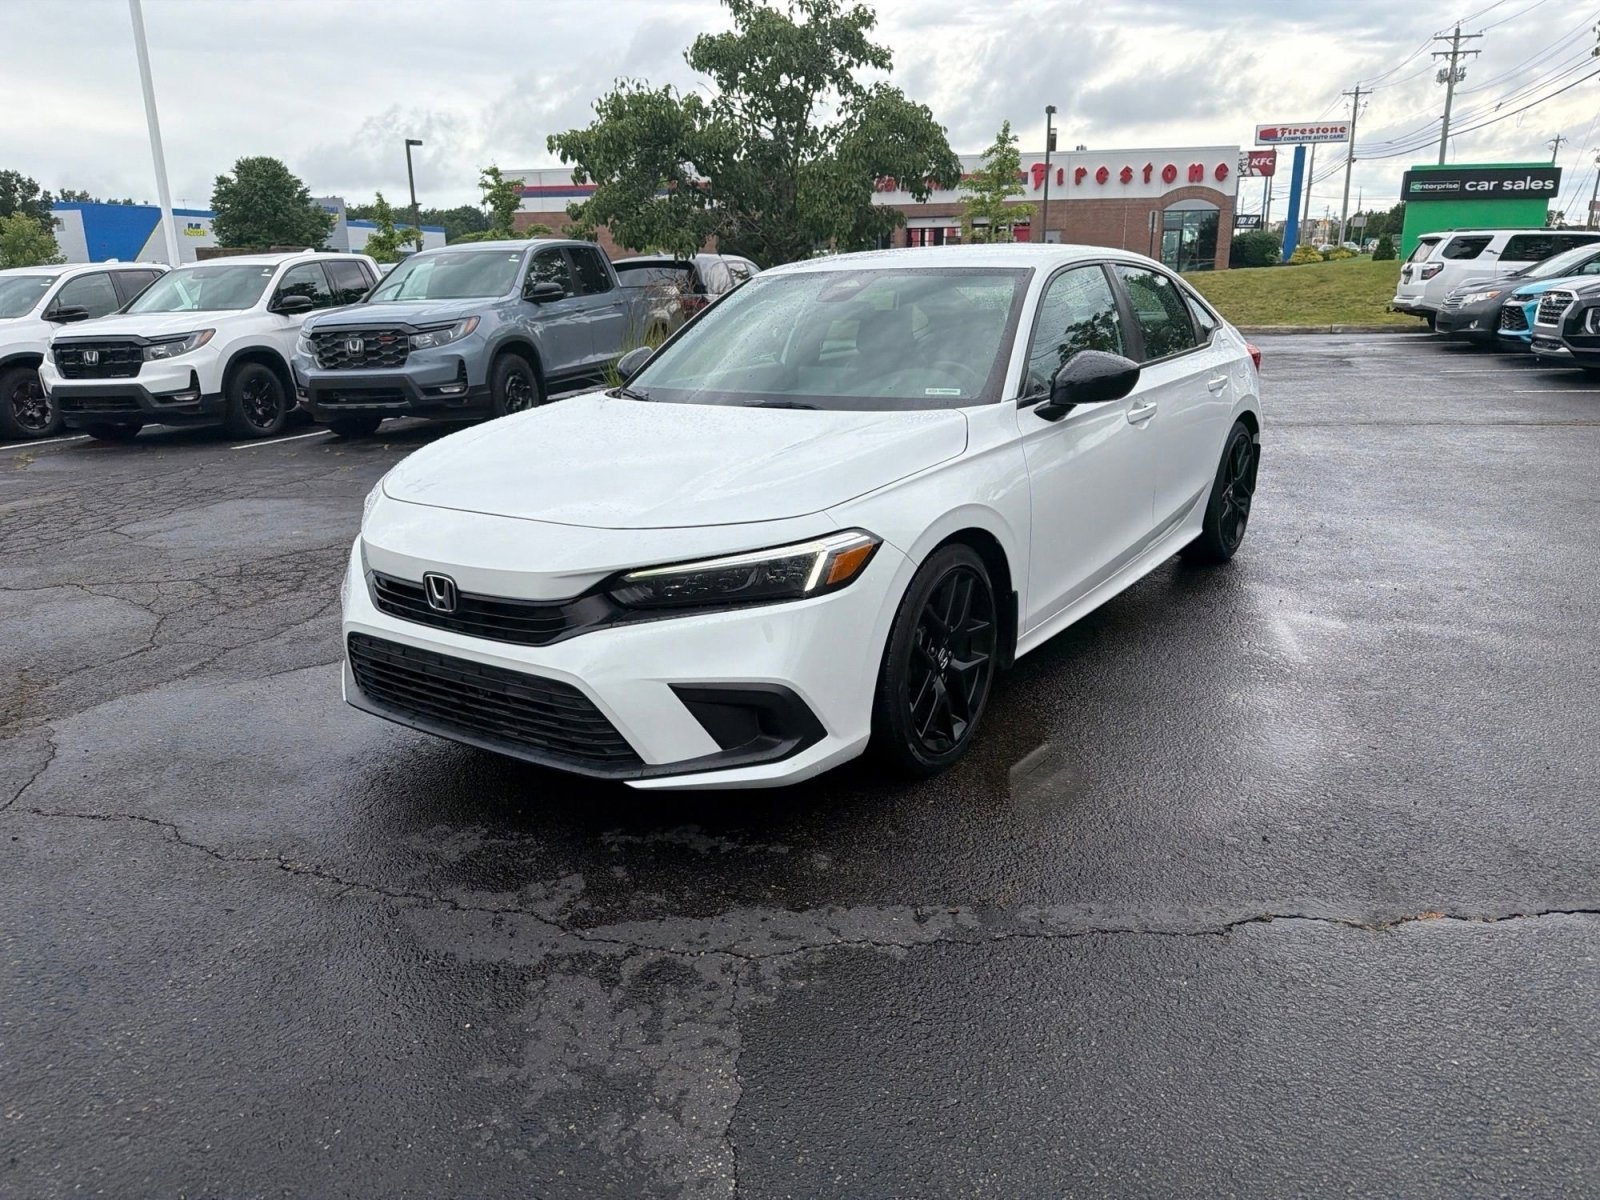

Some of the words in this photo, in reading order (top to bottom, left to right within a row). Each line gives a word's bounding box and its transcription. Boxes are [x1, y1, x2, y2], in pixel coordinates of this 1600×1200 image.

[1280, 126, 1347, 137] Firestone
[1251, 157, 1274, 166] KFC
[1031, 162, 1229, 191] Firestone
[1412, 182, 1459, 191] enterprise
[1465, 180, 1498, 191] car
[1502, 175, 1555, 191] sales
